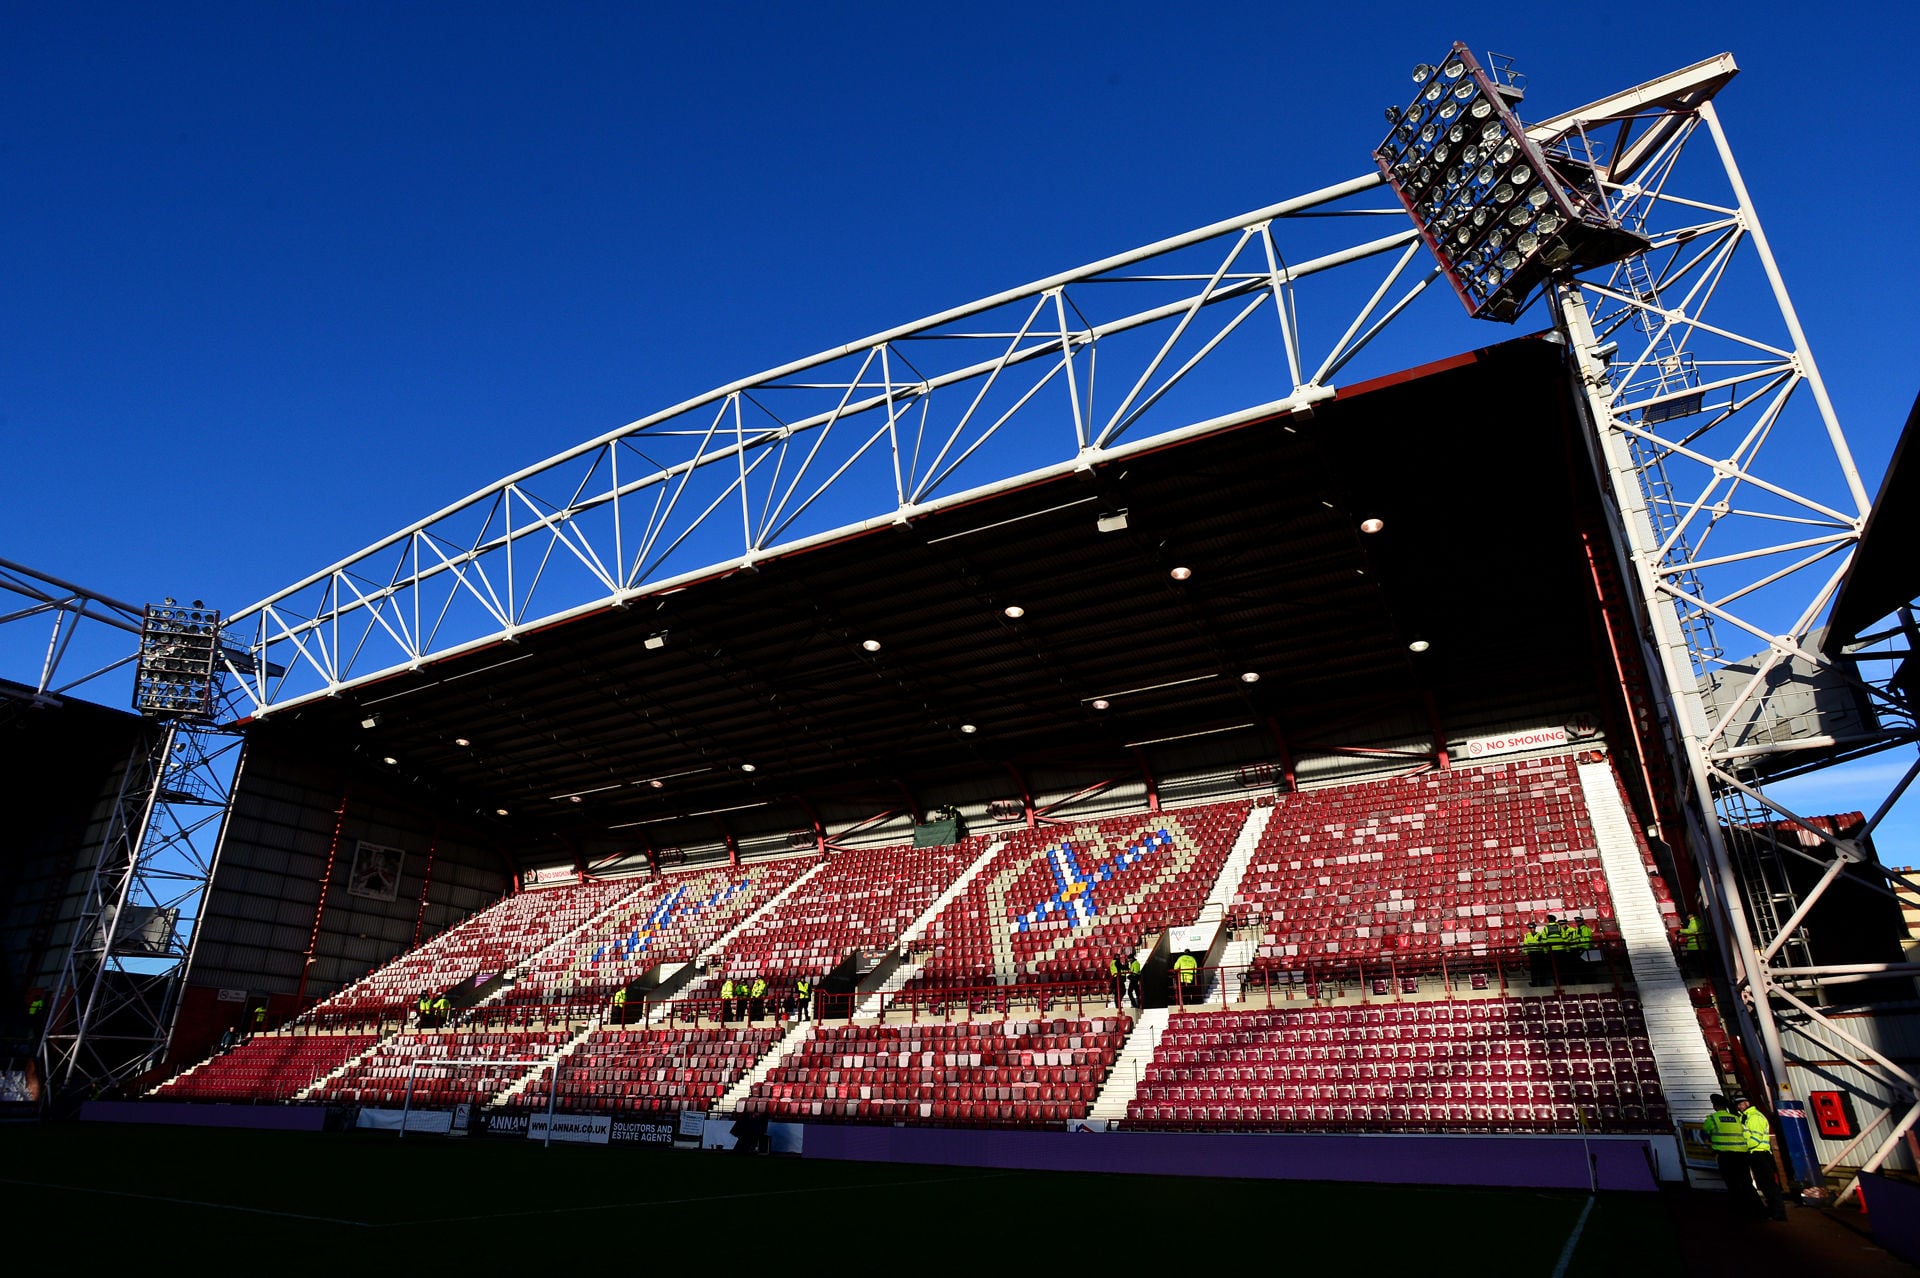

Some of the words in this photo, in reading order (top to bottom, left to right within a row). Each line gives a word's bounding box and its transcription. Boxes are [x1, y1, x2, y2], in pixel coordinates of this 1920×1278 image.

[1575, 714, 1591, 732] M
[1486, 739, 1505, 751] NO
[1508, 731, 1565, 747] SMOKING
[992, 804, 1003, 816] K
[1007, 804, 1018, 816] L
[488, 1115, 528, 1130] ANNAN
[613, 1122, 656, 1133] SOLICITORS
[657, 1124, 673, 1134] AND
[611, 1132, 639, 1142] ESTATE
[640, 1133, 672, 1143] AGENTS
